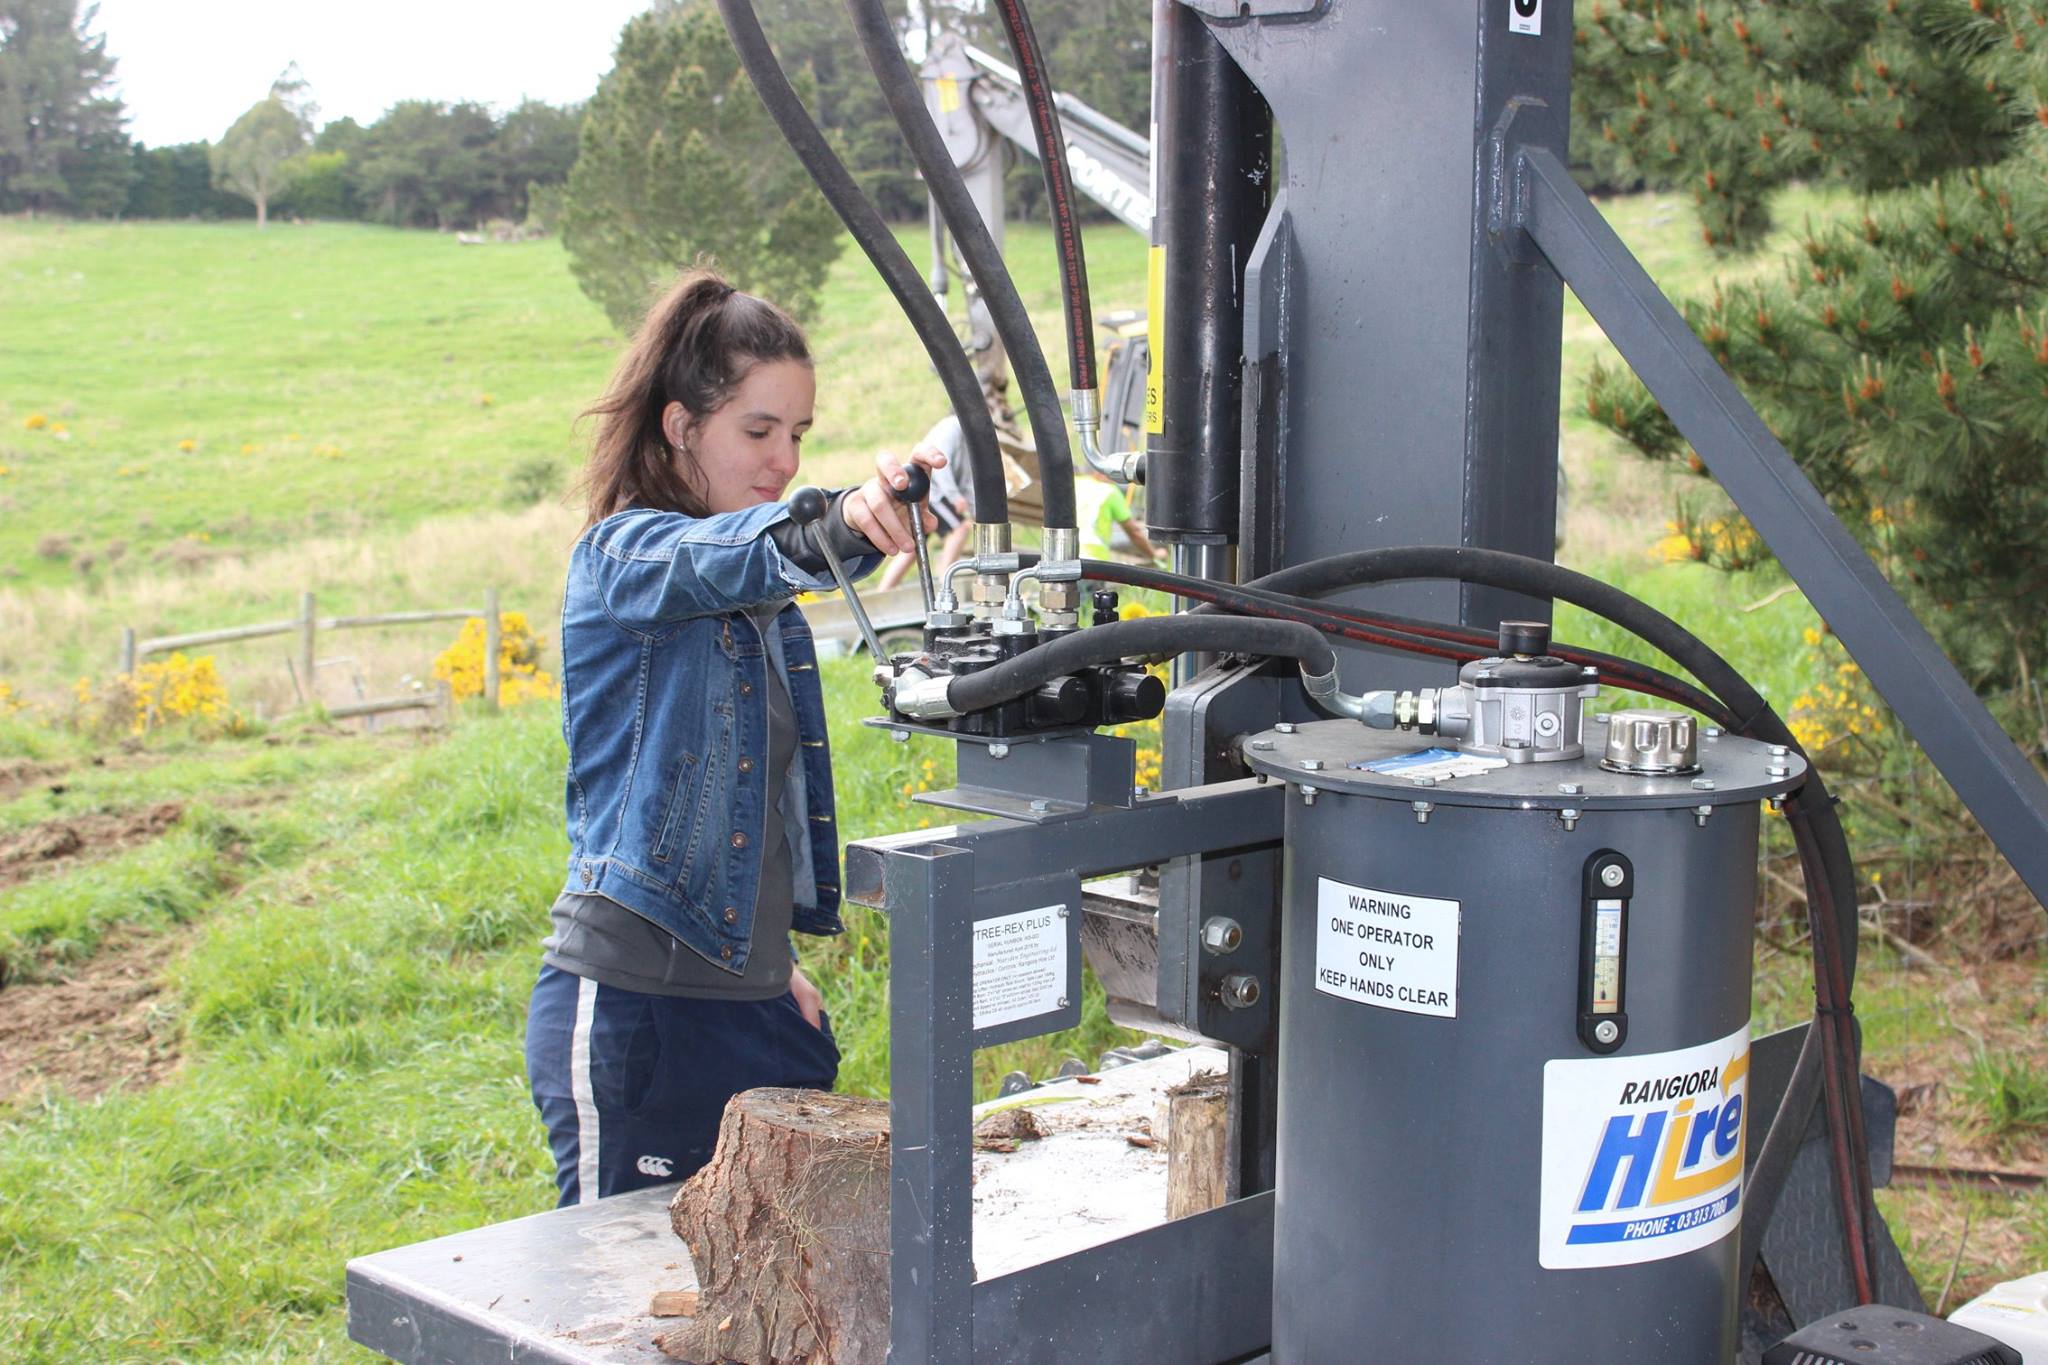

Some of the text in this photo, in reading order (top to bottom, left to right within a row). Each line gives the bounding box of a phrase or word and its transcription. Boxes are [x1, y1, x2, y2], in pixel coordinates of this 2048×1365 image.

[1348, 894, 1411, 919] WARNING
[975, 921, 1024, 941] TREE-REX
[1026, 915, 1051, 930] PLUS
[1331, 917, 1434, 950] ONE OPERATOR
[1359, 951, 1394, 971] ONLY
[1320, 967, 1448, 1007] KEEP HANDS CLEAR
[1620, 1066, 1718, 1105] RANGIORA
[1577, 1094, 1742, 1210] Hire
[1623, 1217, 1669, 1239] PHONE
[1677, 1213, 1692, 1230] 03
[1691, 1206, 1709, 1225] 313
